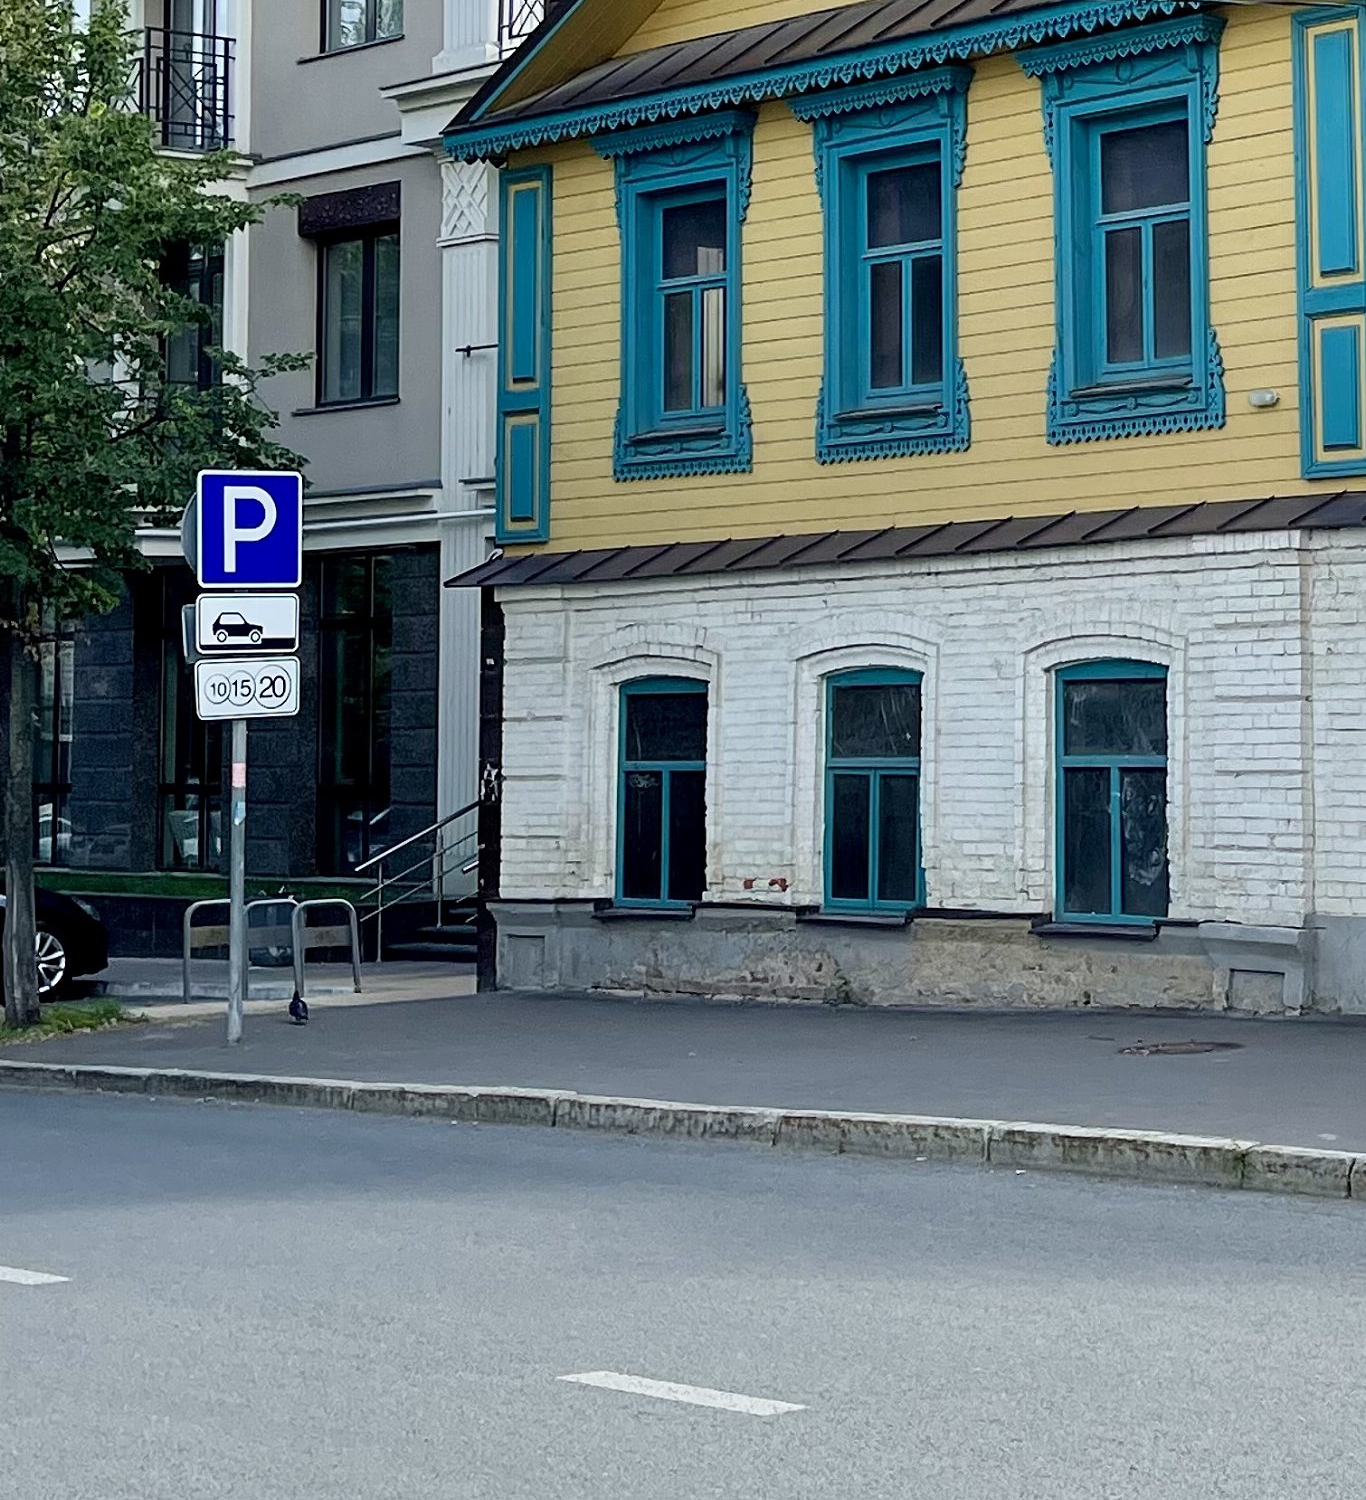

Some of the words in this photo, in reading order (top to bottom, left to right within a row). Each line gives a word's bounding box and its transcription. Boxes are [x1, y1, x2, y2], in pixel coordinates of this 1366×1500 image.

[223, 485, 277, 573] P
[210, 682, 227, 697] 10
[232, 679, 252, 697] 15
[259, 675, 287, 698] 20
